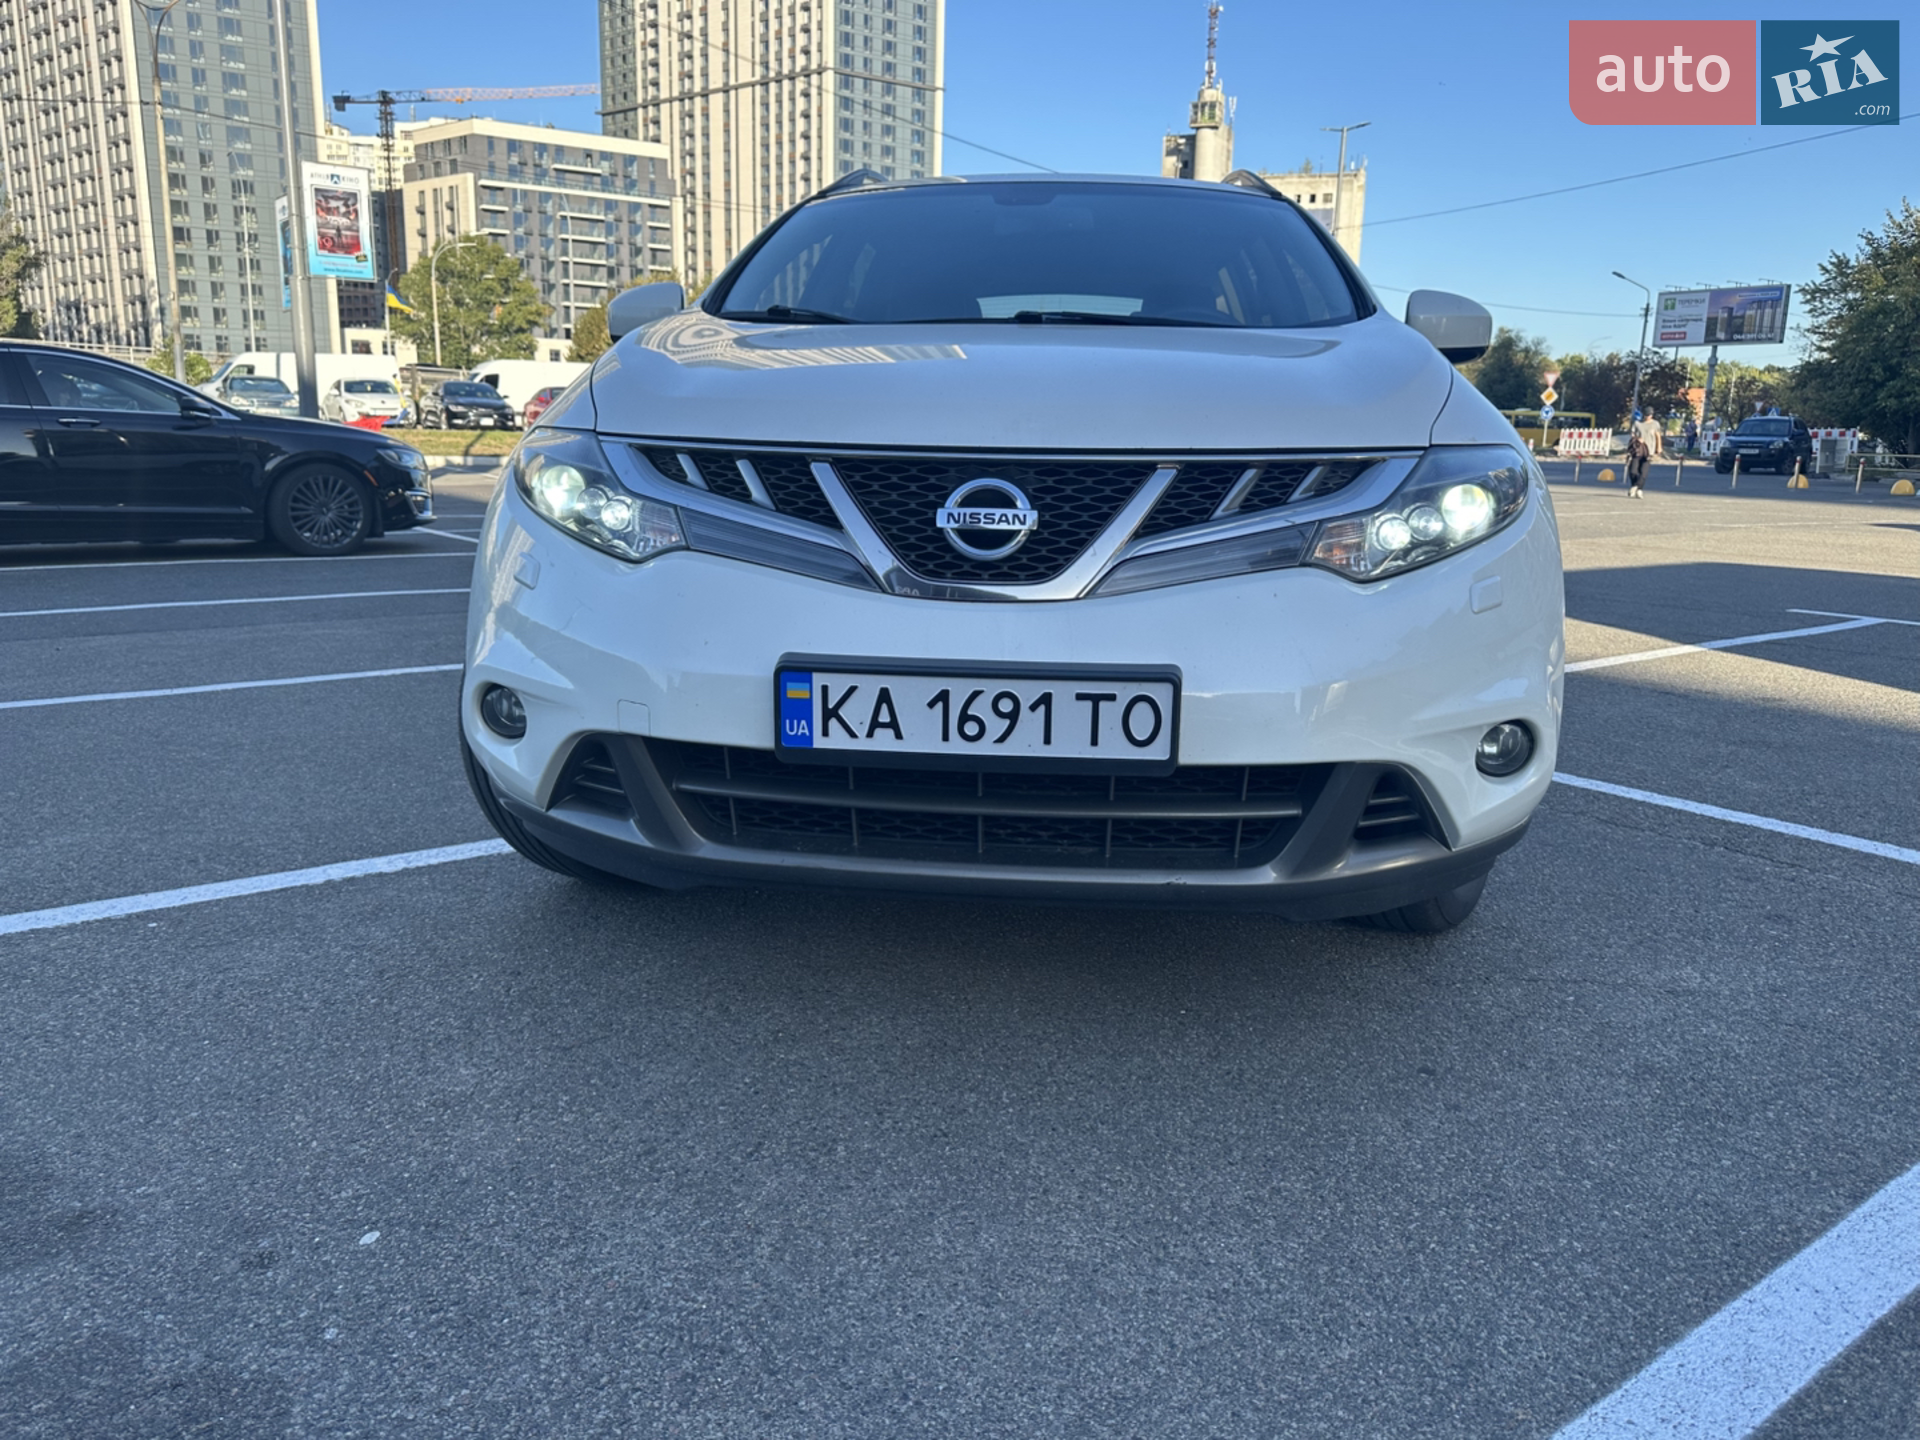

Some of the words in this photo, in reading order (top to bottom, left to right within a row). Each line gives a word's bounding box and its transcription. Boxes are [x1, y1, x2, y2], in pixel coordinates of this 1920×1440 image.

[946, 511, 1027, 526] NISSAN
[820, 684, 904, 740] KA
[926, 688, 1054, 745] 1691
[1075, 692, 1163, 748] TO
[785, 719, 810, 736] UA
